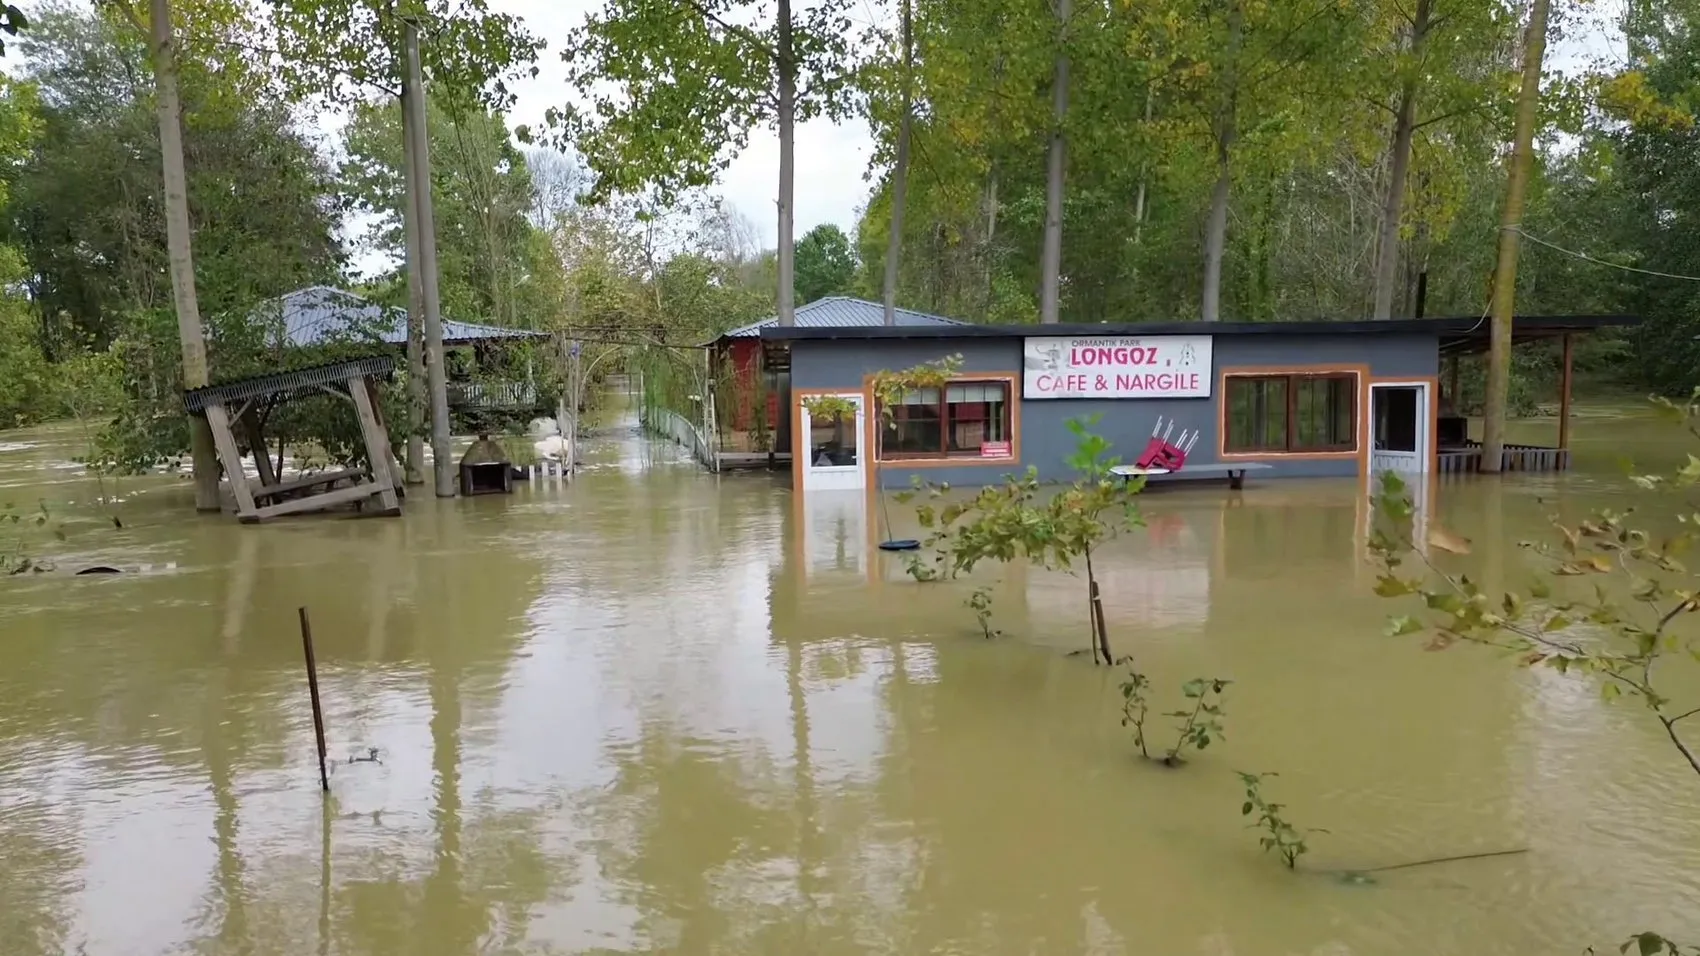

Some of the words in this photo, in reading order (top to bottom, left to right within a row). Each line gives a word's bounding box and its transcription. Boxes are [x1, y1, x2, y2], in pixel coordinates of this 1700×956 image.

[1072, 347, 1157, 365] LONGOZ
[1037, 375, 1087, 391] CAFE
[1095, 375, 1108, 391] &
[1116, 369, 1199, 391] NARGİLE
